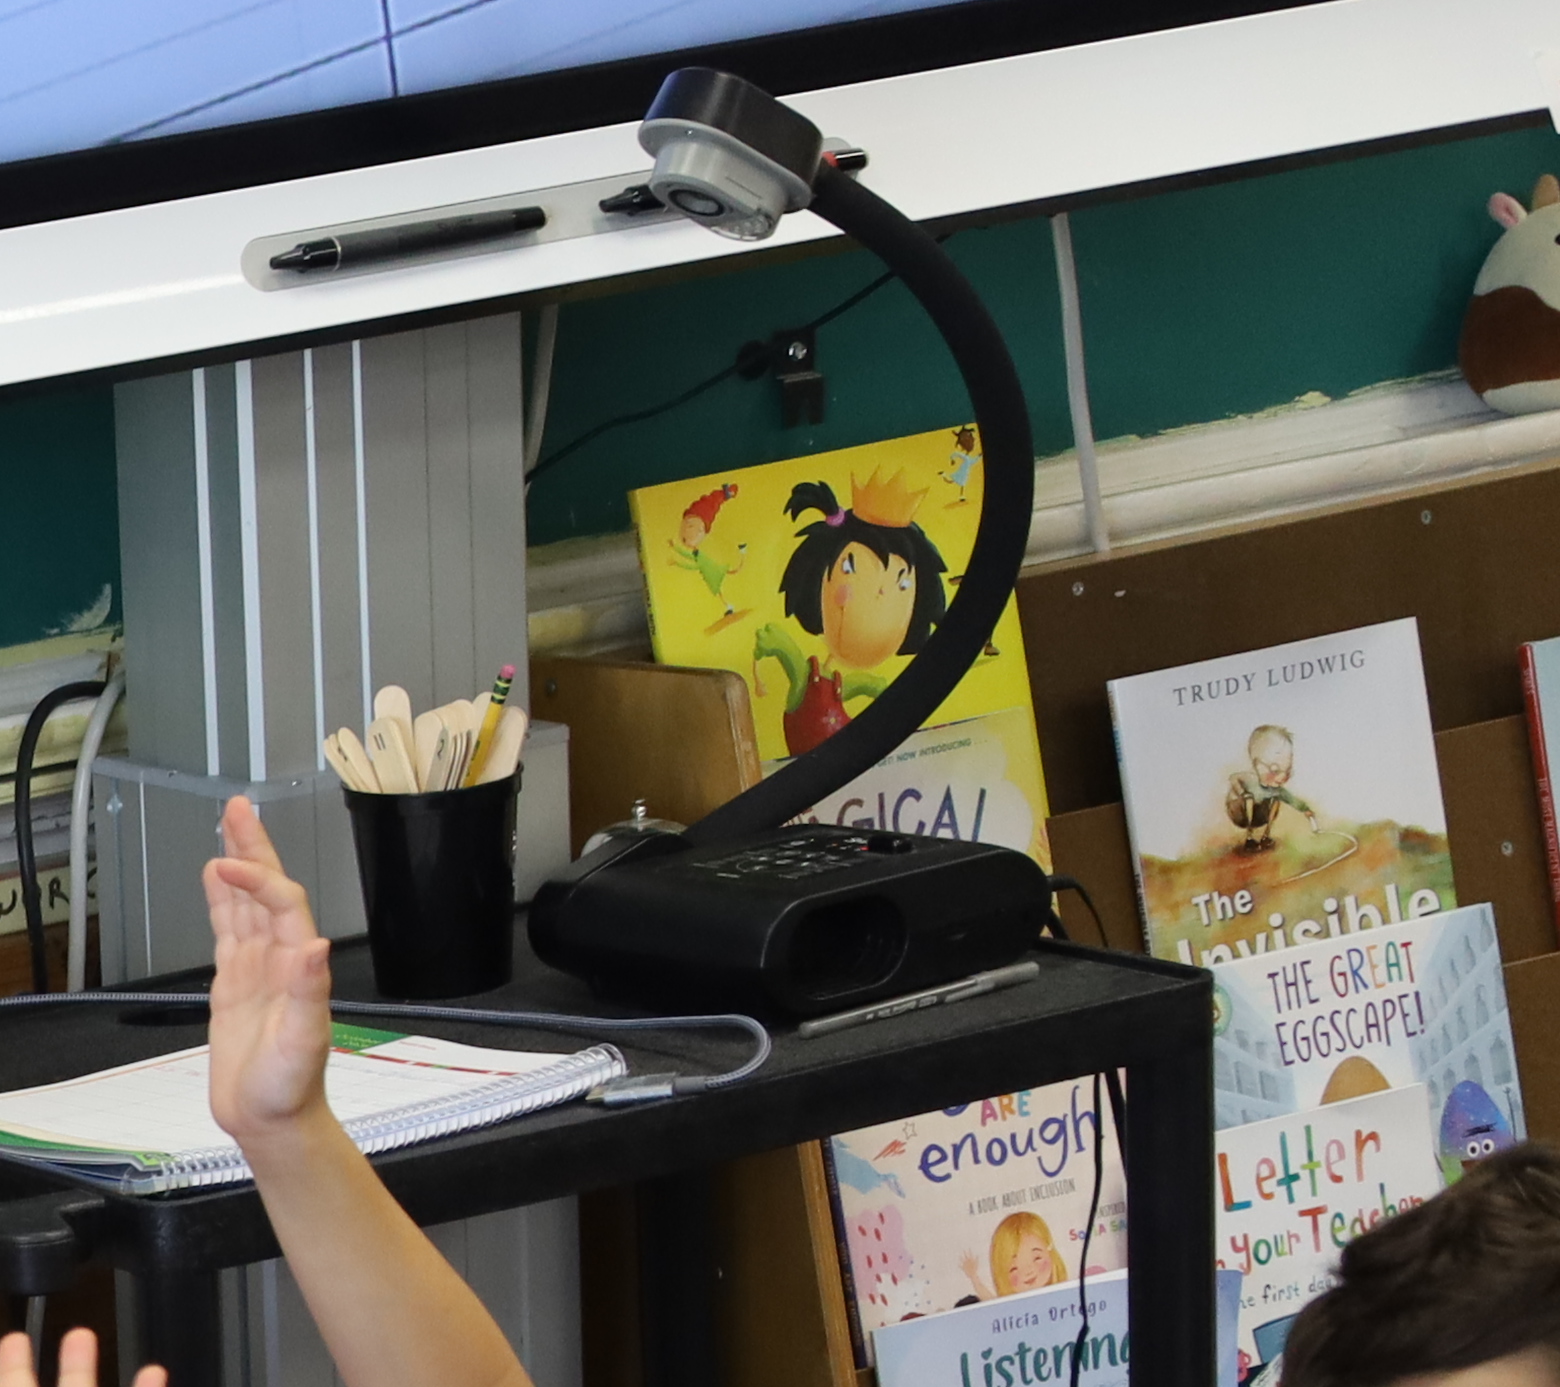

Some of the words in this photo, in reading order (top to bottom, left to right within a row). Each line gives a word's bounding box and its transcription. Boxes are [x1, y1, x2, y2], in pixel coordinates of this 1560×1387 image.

[1172, 671, 1257, 706] TRUDY
[1266, 649, 1367, 688] LUDWIG
[896, 749, 918, 763] NOW
[919, 738, 973, 758] INTRODUCING
[1191, 889, 1254, 927] The
[1267, 959, 1321, 1015] THE
[1329, 941, 1416, 998] GREAT
[1274, 991, 1426, 1067] EGGSCAPE!
[980, 1090, 1032, 1127] ARE
[918, 1085, 1097, 1183] enough
[1218, 1124, 1382, 1213] Letter
[968, 1202, 976, 1216] A
[977, 1195, 999, 1213] BOOK
[1002, 1189, 1027, 1209] ABOUT
[1030, 1178, 1077, 1205] INCLUSION
[1230, 1229, 1301, 1276] your
[1262, 1283, 1301, 1306] first
[992, 1311, 1040, 1335] Alicia
[1049, 1300, 1108, 1324] Ortgo
